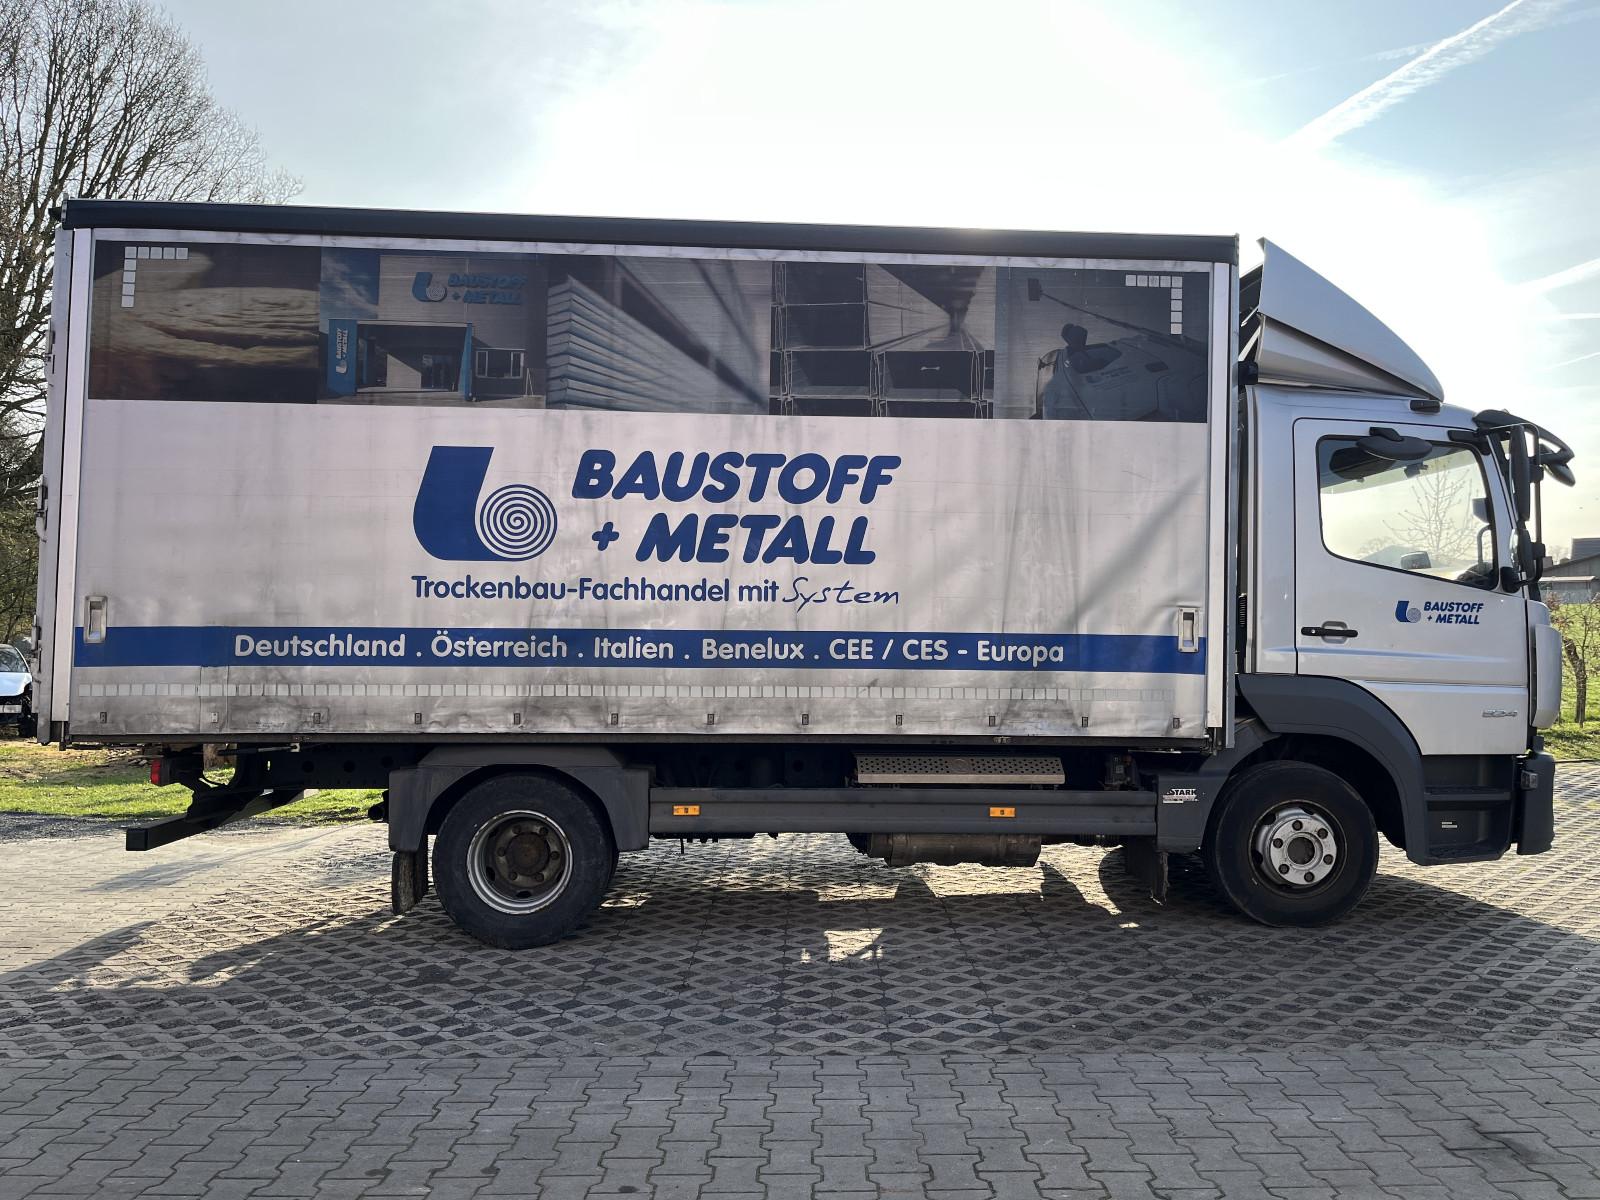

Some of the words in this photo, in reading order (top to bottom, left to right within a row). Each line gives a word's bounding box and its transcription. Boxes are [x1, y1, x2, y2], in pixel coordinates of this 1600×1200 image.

[571, 449, 902, 505] BAUSTOFF
[635, 512, 876, 565] METALL
[411, 574, 730, 602] Trockenbau-Fachhandel
[738, 579, 780, 602] mit
[782, 576, 899, 613] System
[1423, 601, 1484, 613] BAUSTOFF
[1435, 613, 1480, 625] METALL
[234, 633, 406, 657] Deutschland
[431, 630, 568, 658] Österreich
[594, 635, 674, 660] Italien
[702, 637, 805, 660] Benelux
[829, 638, 874, 660] CEE
[902, 639, 949, 661] CES
[977, 640, 1064, 667] Europa
